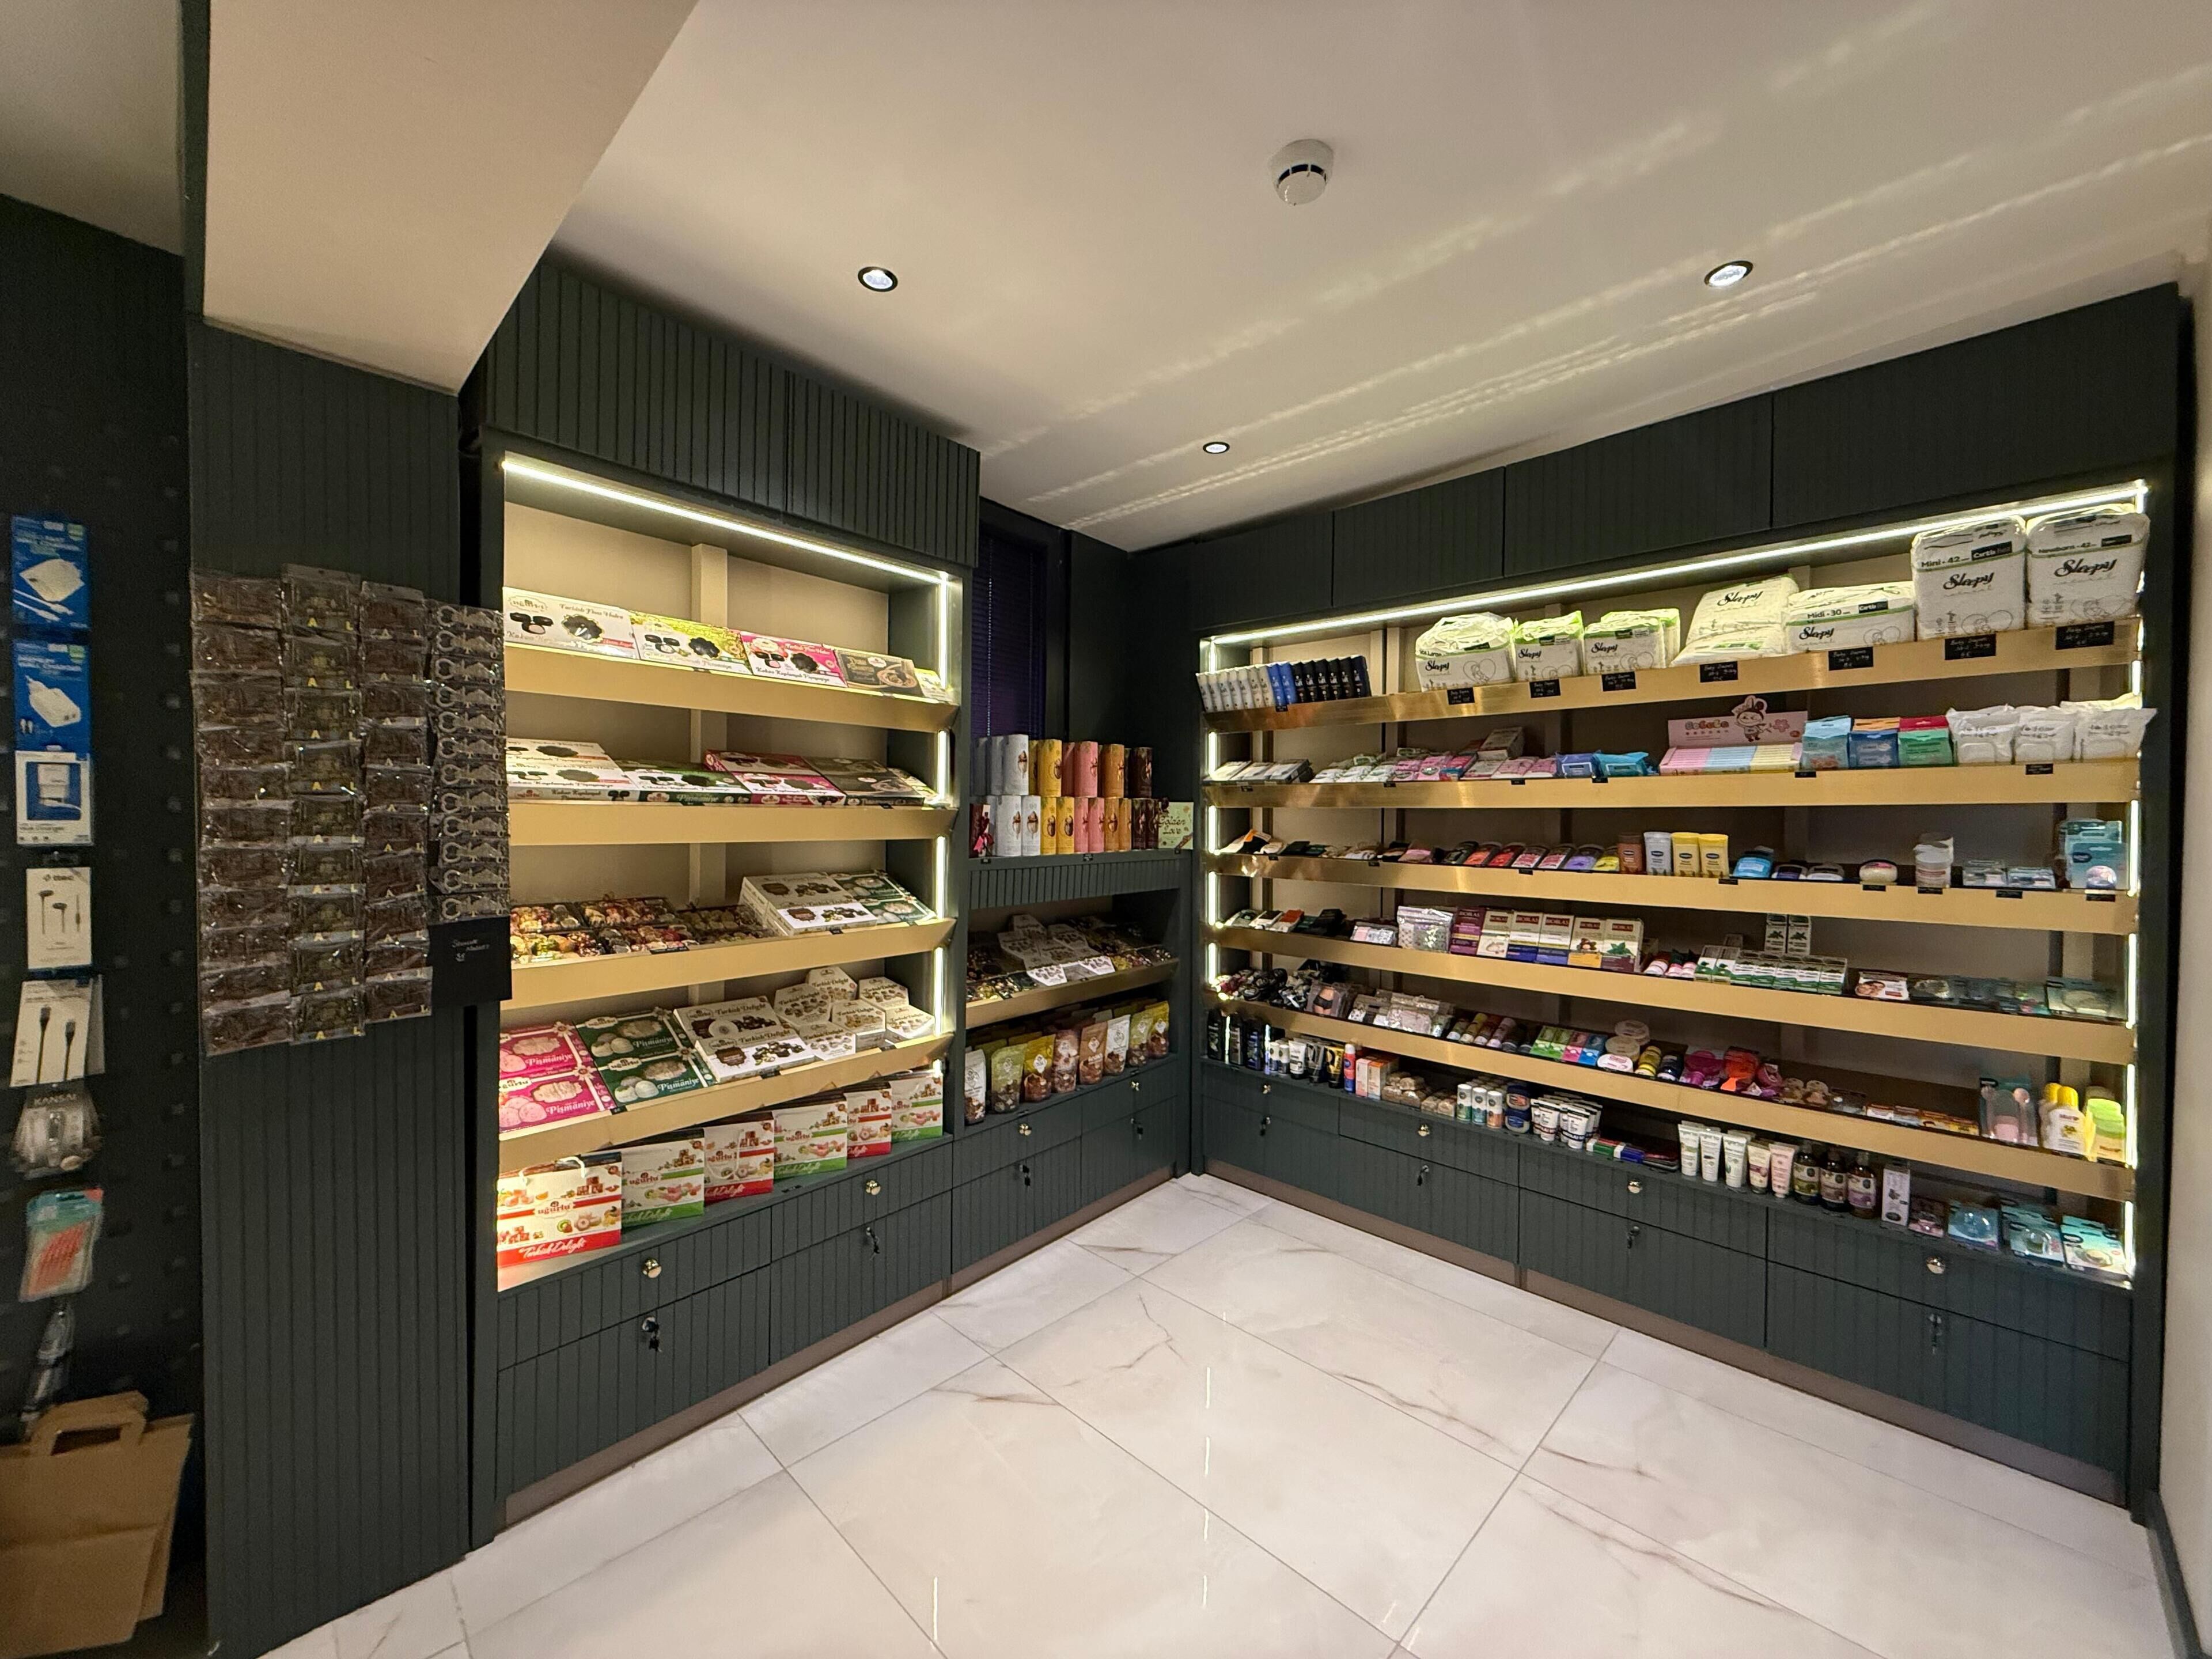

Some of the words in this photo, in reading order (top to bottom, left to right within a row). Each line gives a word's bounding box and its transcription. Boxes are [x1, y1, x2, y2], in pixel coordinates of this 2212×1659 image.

[1921, 559, 1941, 567] Mini
[1948, 556, 1960, 564] 42
[2054, 558, 2118, 577] Sleepy
[1943, 571, 1994, 590] Sleepy
[1717, 590, 1764, 606] Sleepy
[1799, 626, 1835, 640] Sleepy
[1518, 648, 1542, 659] Sleepy
[1590, 642, 1618, 654] Sleepy
[1425, 660, 1450, 672] Sleepy
[1158, 815, 1186, 828] Golden
[1162, 825, 1181, 835] Love
[832, 978, 849, 986] Delight
[801, 991, 820, 1001] Delight
[715, 1007, 740, 1016] Turkish
[741, 1003, 767, 1013] Delight
[739, 1035, 764, 1043] Turkish
[764, 1029, 791, 1039] Delight
[33, 1094, 77, 1105] KANSAI
[629, 1175, 659, 1185] uğurlu
[537, 1205, 570, 1215] uğurlu
[519, 1243, 552, 1259] Turkish
[551, 1237, 588, 1254] Delight
